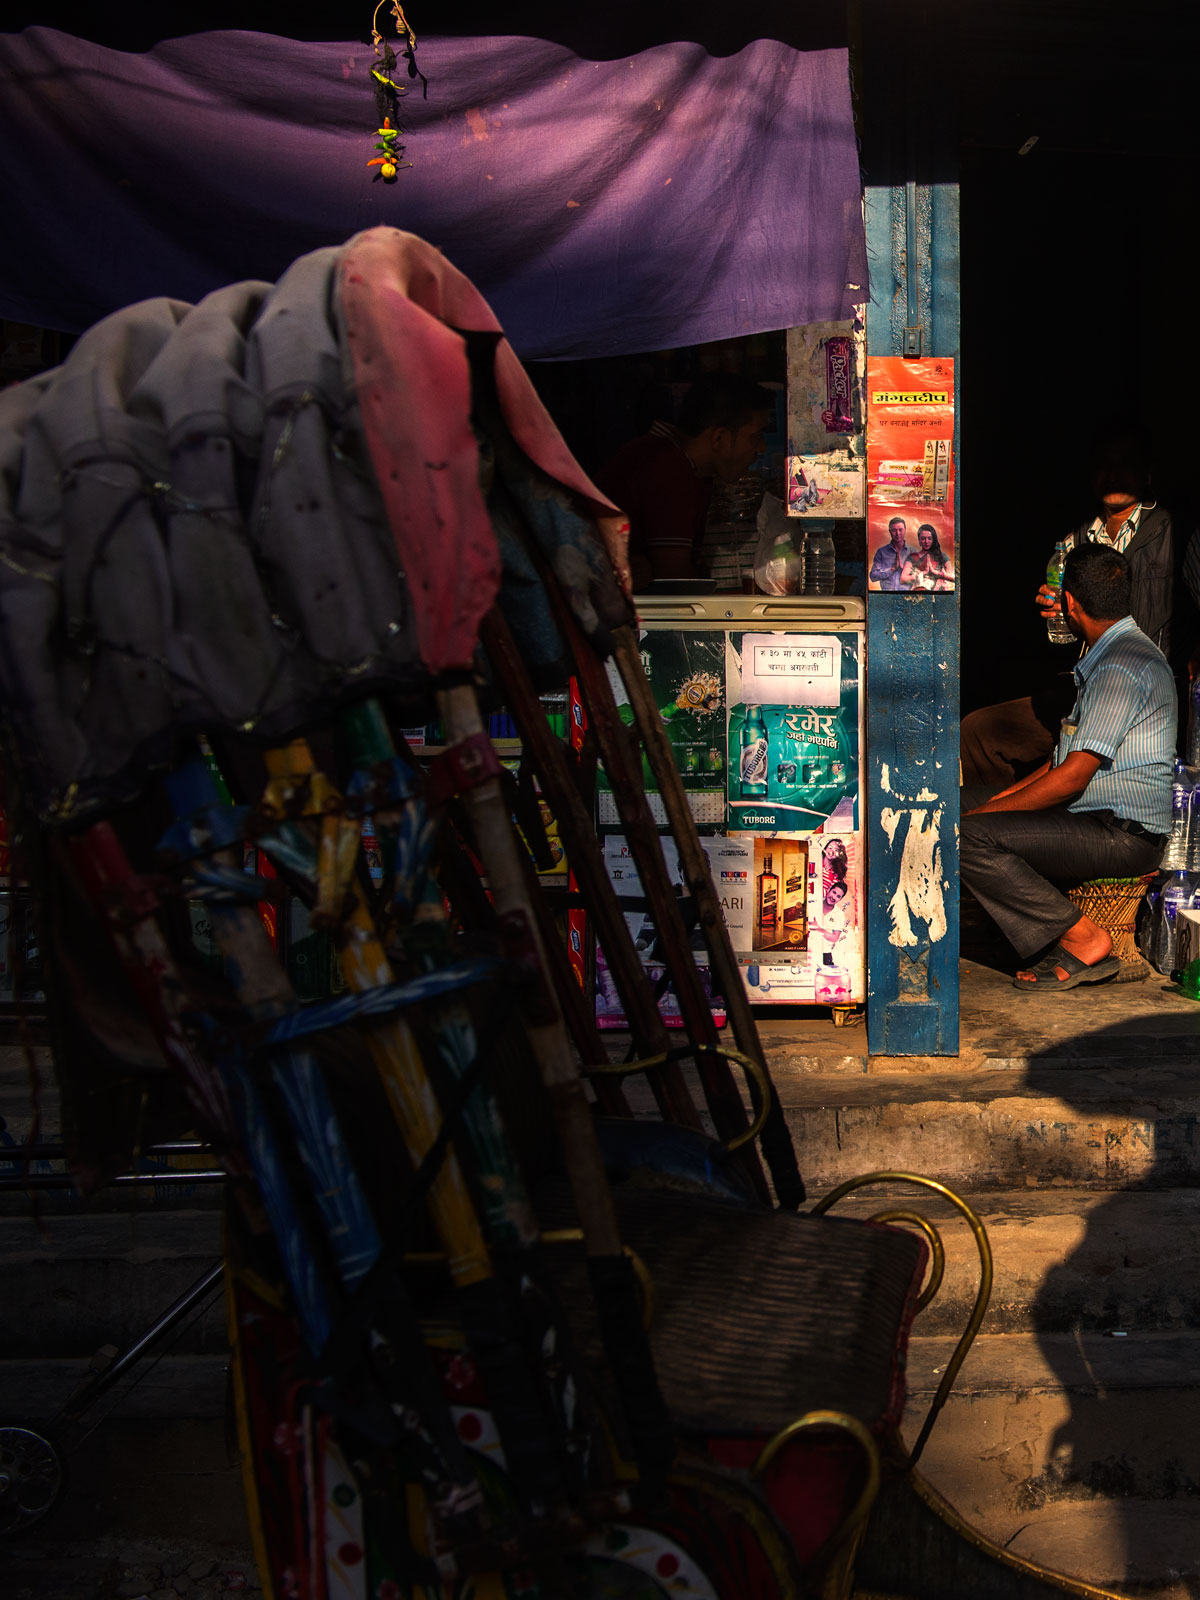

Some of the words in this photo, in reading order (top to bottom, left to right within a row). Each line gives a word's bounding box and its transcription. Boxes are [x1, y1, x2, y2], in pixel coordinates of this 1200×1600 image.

[876, 392, 946, 402] मंगलदीप
[744, 746, 766, 780] TUBORG
[743, 816, 776, 824] TUBORG
